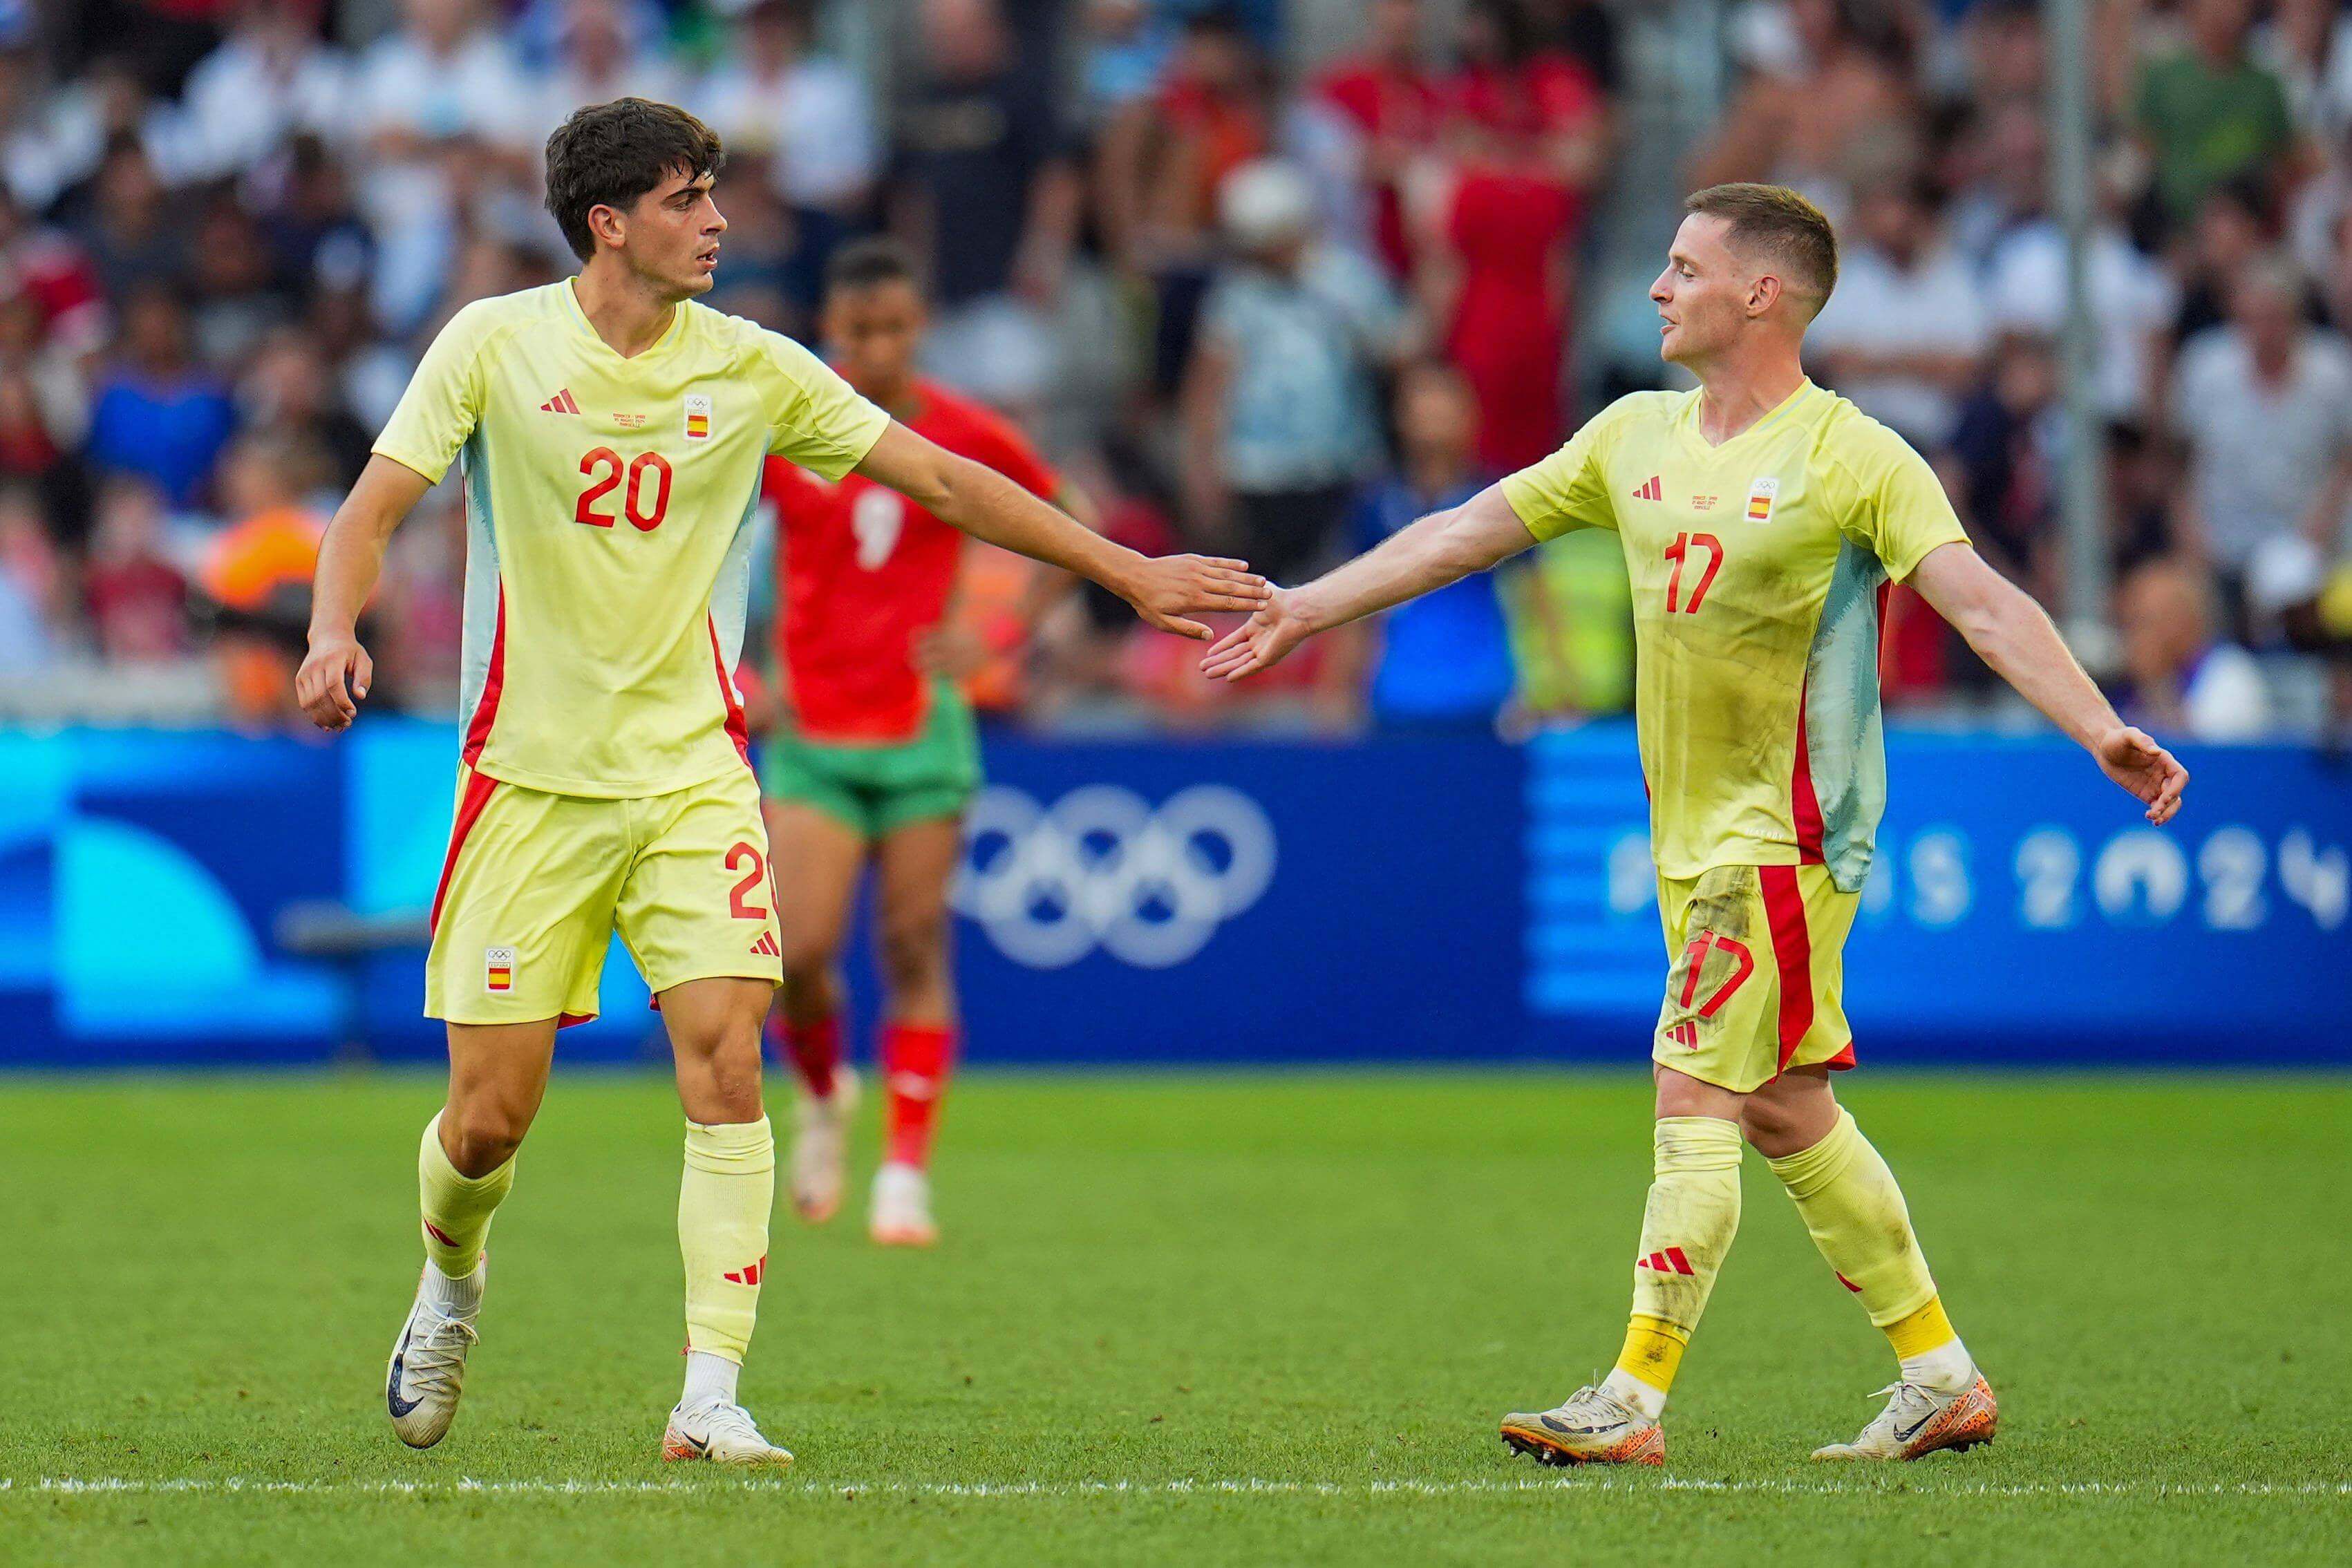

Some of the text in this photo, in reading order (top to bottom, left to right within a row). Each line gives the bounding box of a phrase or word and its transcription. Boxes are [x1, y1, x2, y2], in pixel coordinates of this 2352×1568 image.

[576, 446, 672, 532] 20
[852, 487, 904, 572] 9
[1664, 531, 1724, 614] 17
[724, 841, 780, 920] 2
[1607, 826, 2347, 930] PIS 2024
[1680, 929, 1754, 1018] 17
